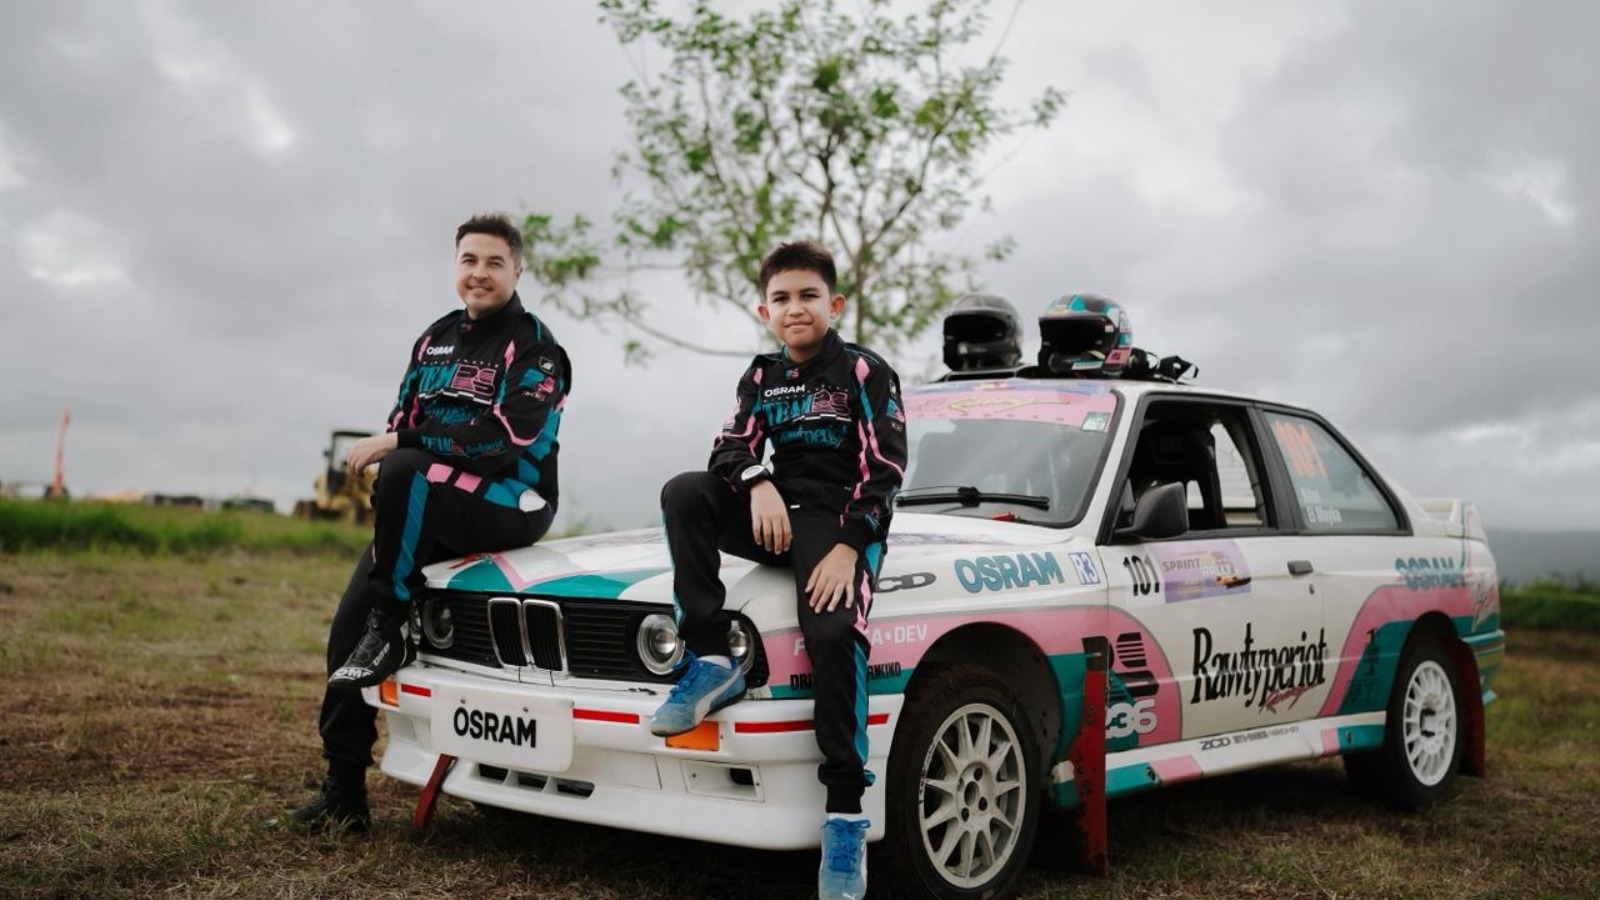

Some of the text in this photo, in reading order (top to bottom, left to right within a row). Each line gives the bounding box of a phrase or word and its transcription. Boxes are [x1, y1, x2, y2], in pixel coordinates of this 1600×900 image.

[764, 384, 806, 398] OSRAM
[954, 551, 1064, 594] OSRAM
[1122, 555, 1160, 596] 101
[1162, 557, 1201, 572] SPRINT
[874, 571, 937, 594] CD
[453, 706, 537, 749] OSRAM
